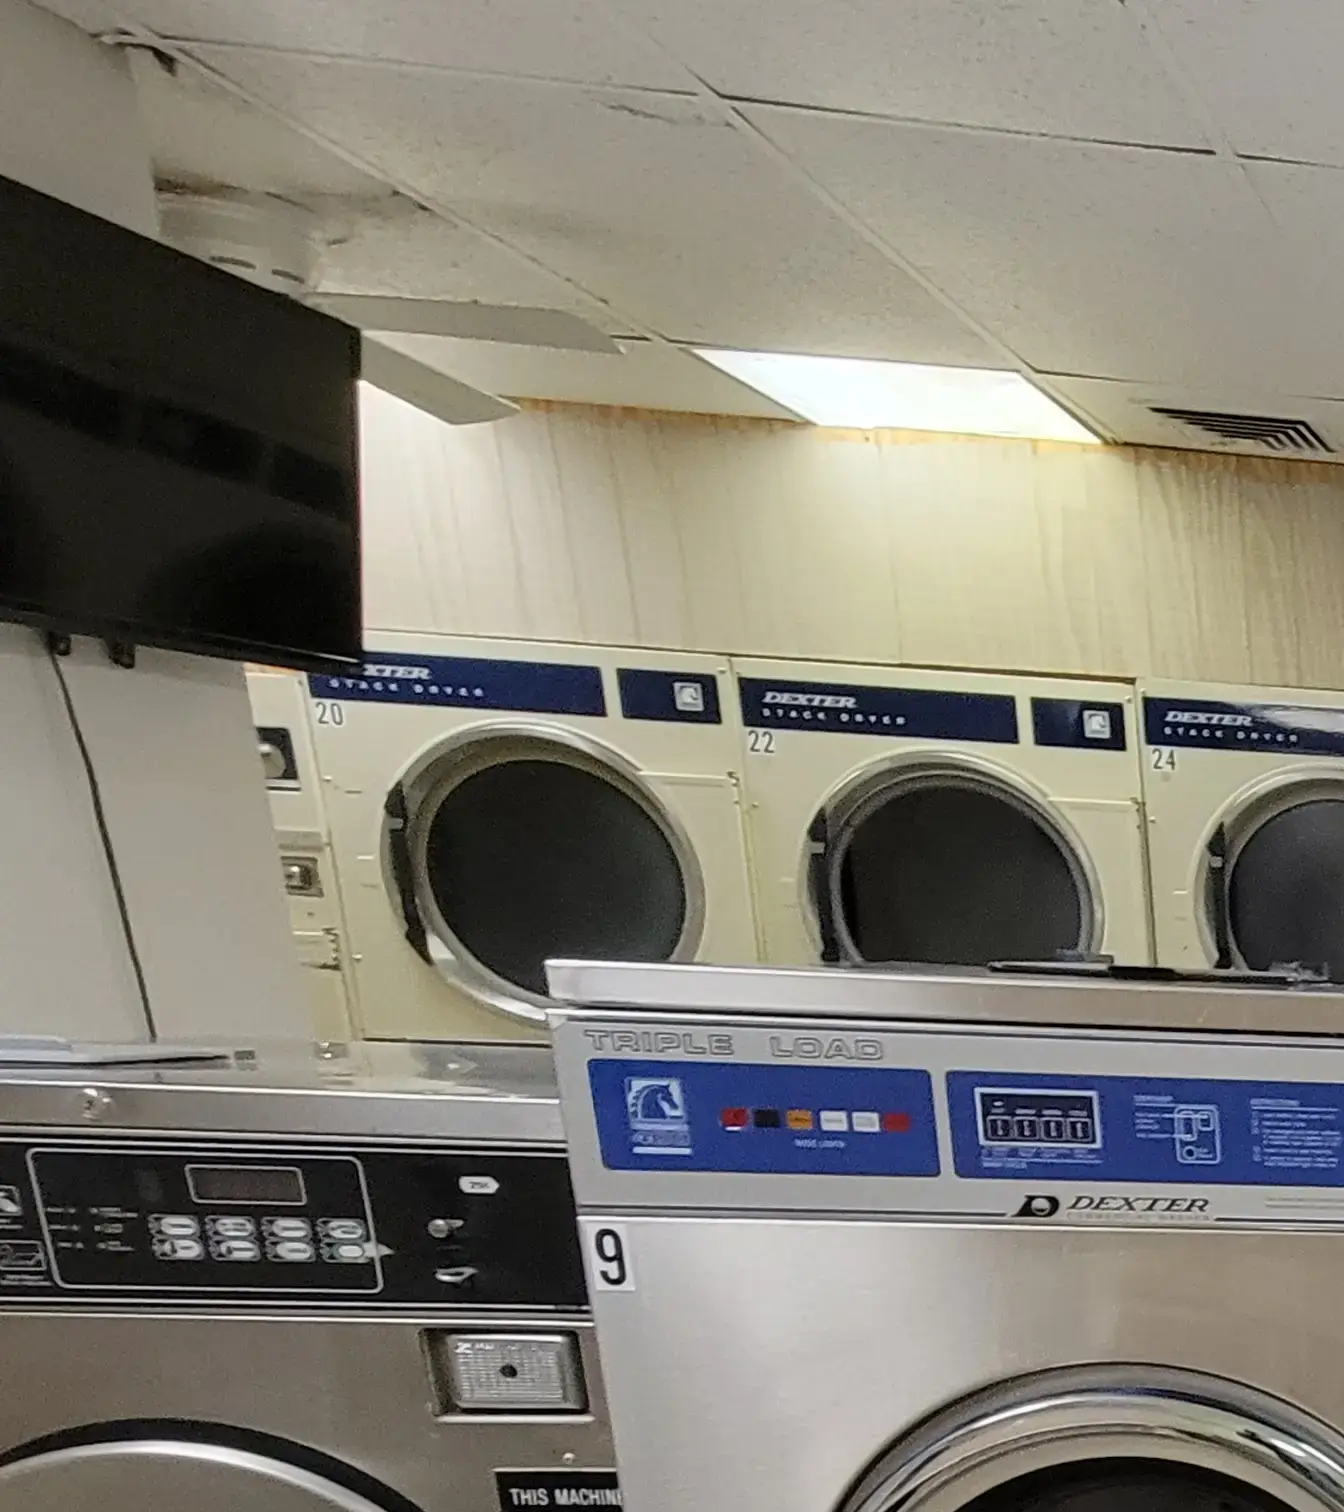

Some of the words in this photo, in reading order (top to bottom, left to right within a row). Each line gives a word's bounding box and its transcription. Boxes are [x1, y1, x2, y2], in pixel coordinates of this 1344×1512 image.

[363, 663, 432, 680] XTER
[762, 691, 858, 708] DEXTER
[316, 701, 344, 726] 20
[1164, 711, 1252, 726] DEXTER
[748, 729, 775, 754] 22
[1152, 748, 1176, 771] 24
[584, 1028, 735, 1056] TRIPLE
[768, 1035, 885, 1061] LOAD
[1067, 1195, 1210, 1212] DEXTER
[595, 1228, 626, 1286] 9
[508, 1488, 549, 1505] THIS
